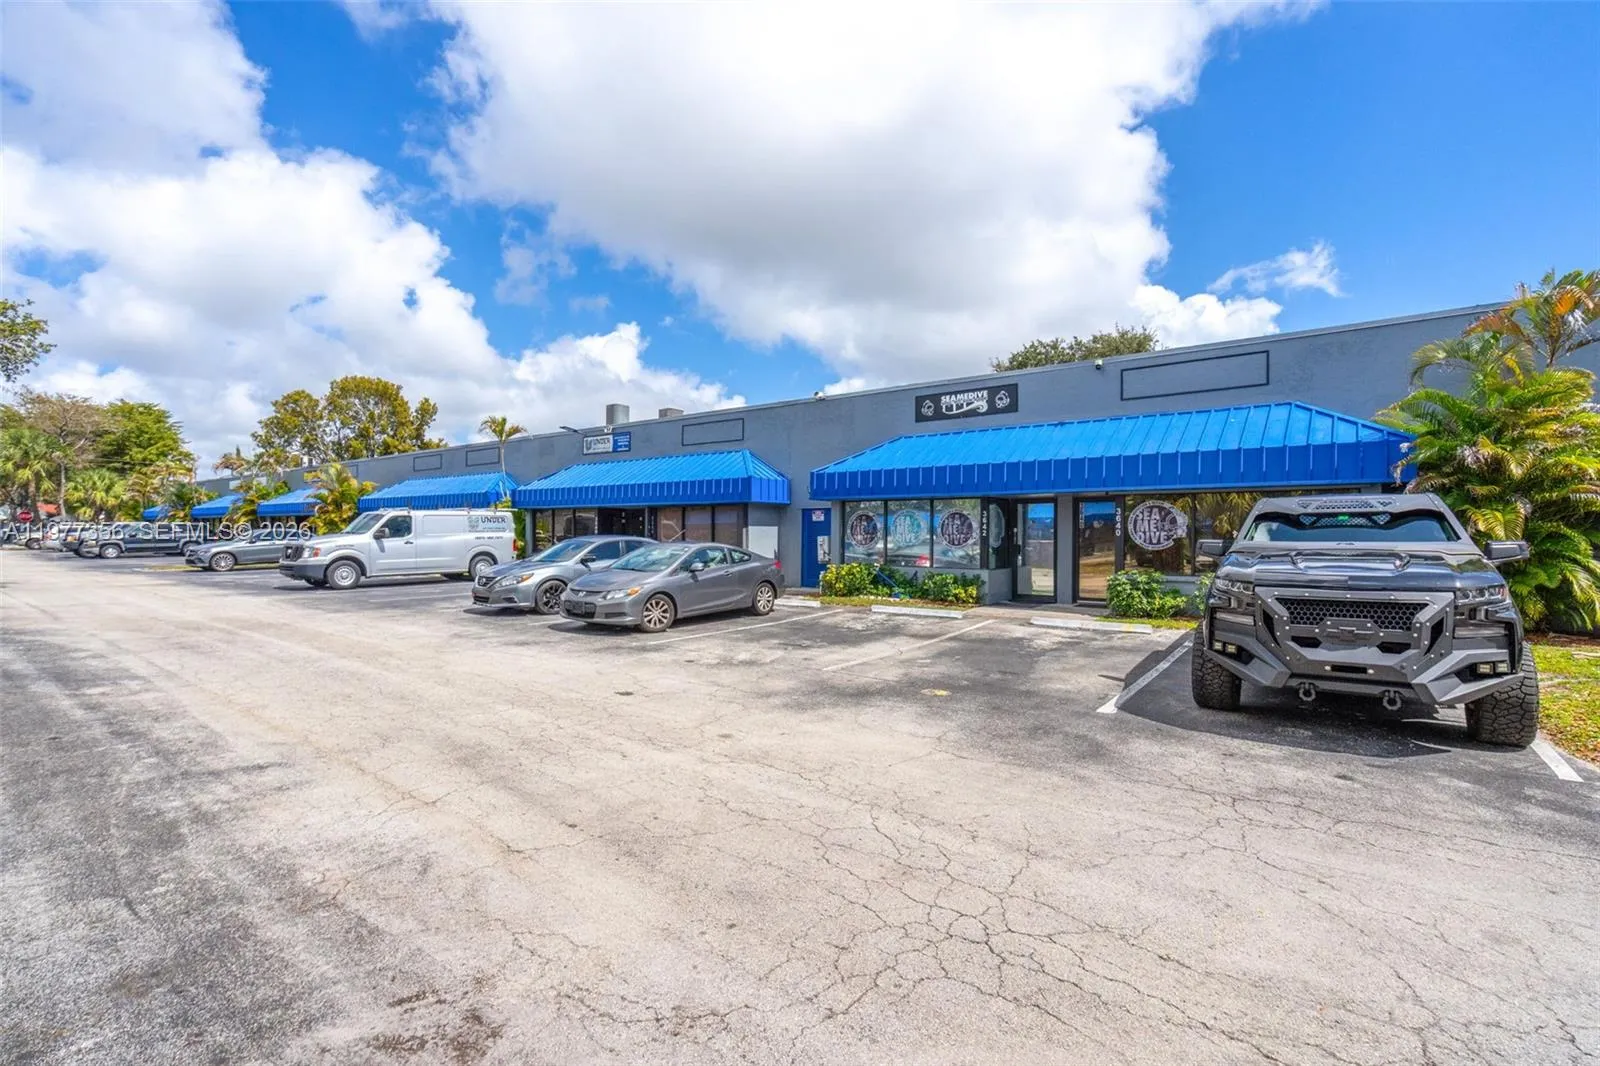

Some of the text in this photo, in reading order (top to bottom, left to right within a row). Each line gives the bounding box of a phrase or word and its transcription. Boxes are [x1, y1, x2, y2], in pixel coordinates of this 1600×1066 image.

[941, 390, 988, 403] SEAMEDIVE
[1136, 508, 1160, 520] SEA
[1136, 520, 1158, 532] ME
[1136, 532, 1168, 544] DIVE
